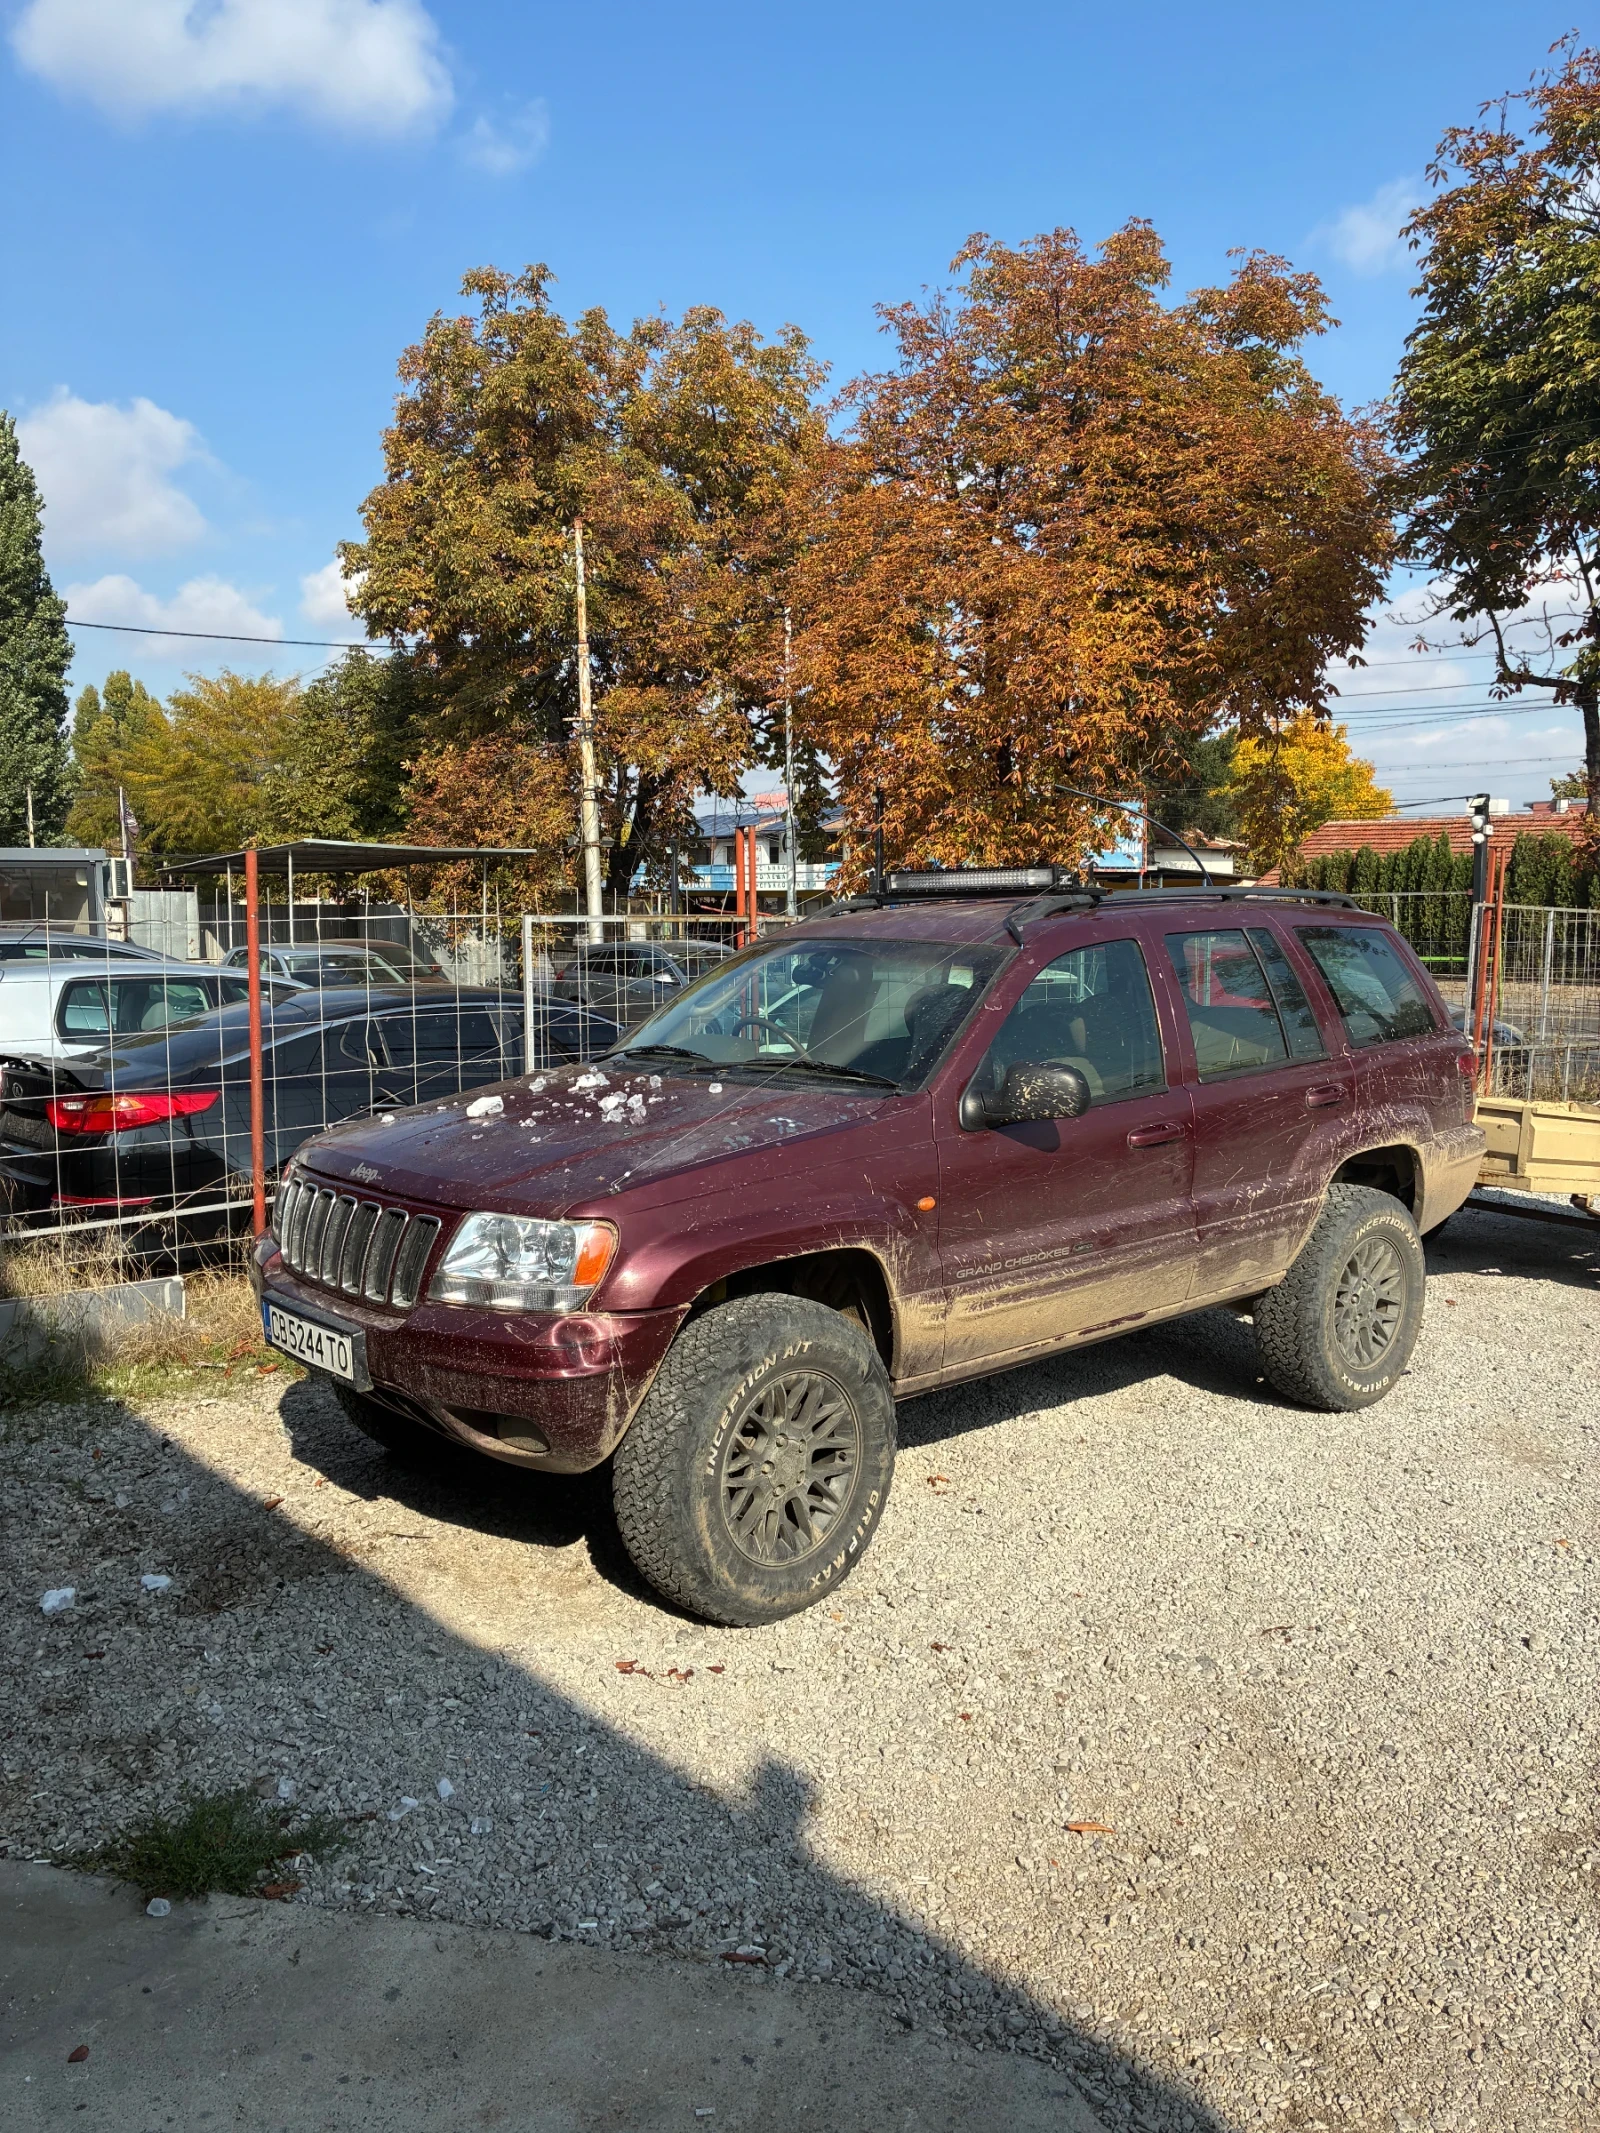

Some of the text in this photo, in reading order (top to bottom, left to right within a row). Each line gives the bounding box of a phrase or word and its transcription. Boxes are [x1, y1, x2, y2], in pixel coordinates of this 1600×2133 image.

[350, 1161, 378, 1183] Jeep
[1355, 1216, 1419, 1249] INCEPTION A/T
[955, 1261, 1002, 1279] GRAND
[1004, 1246, 1070, 1268] CHEROKEE
[1341, 1372, 1389, 1393] GRIPMAX
[706, 1341, 813, 1476] INCEPTION A/T
[810, 1490, 880, 1589] GRIPMAX
